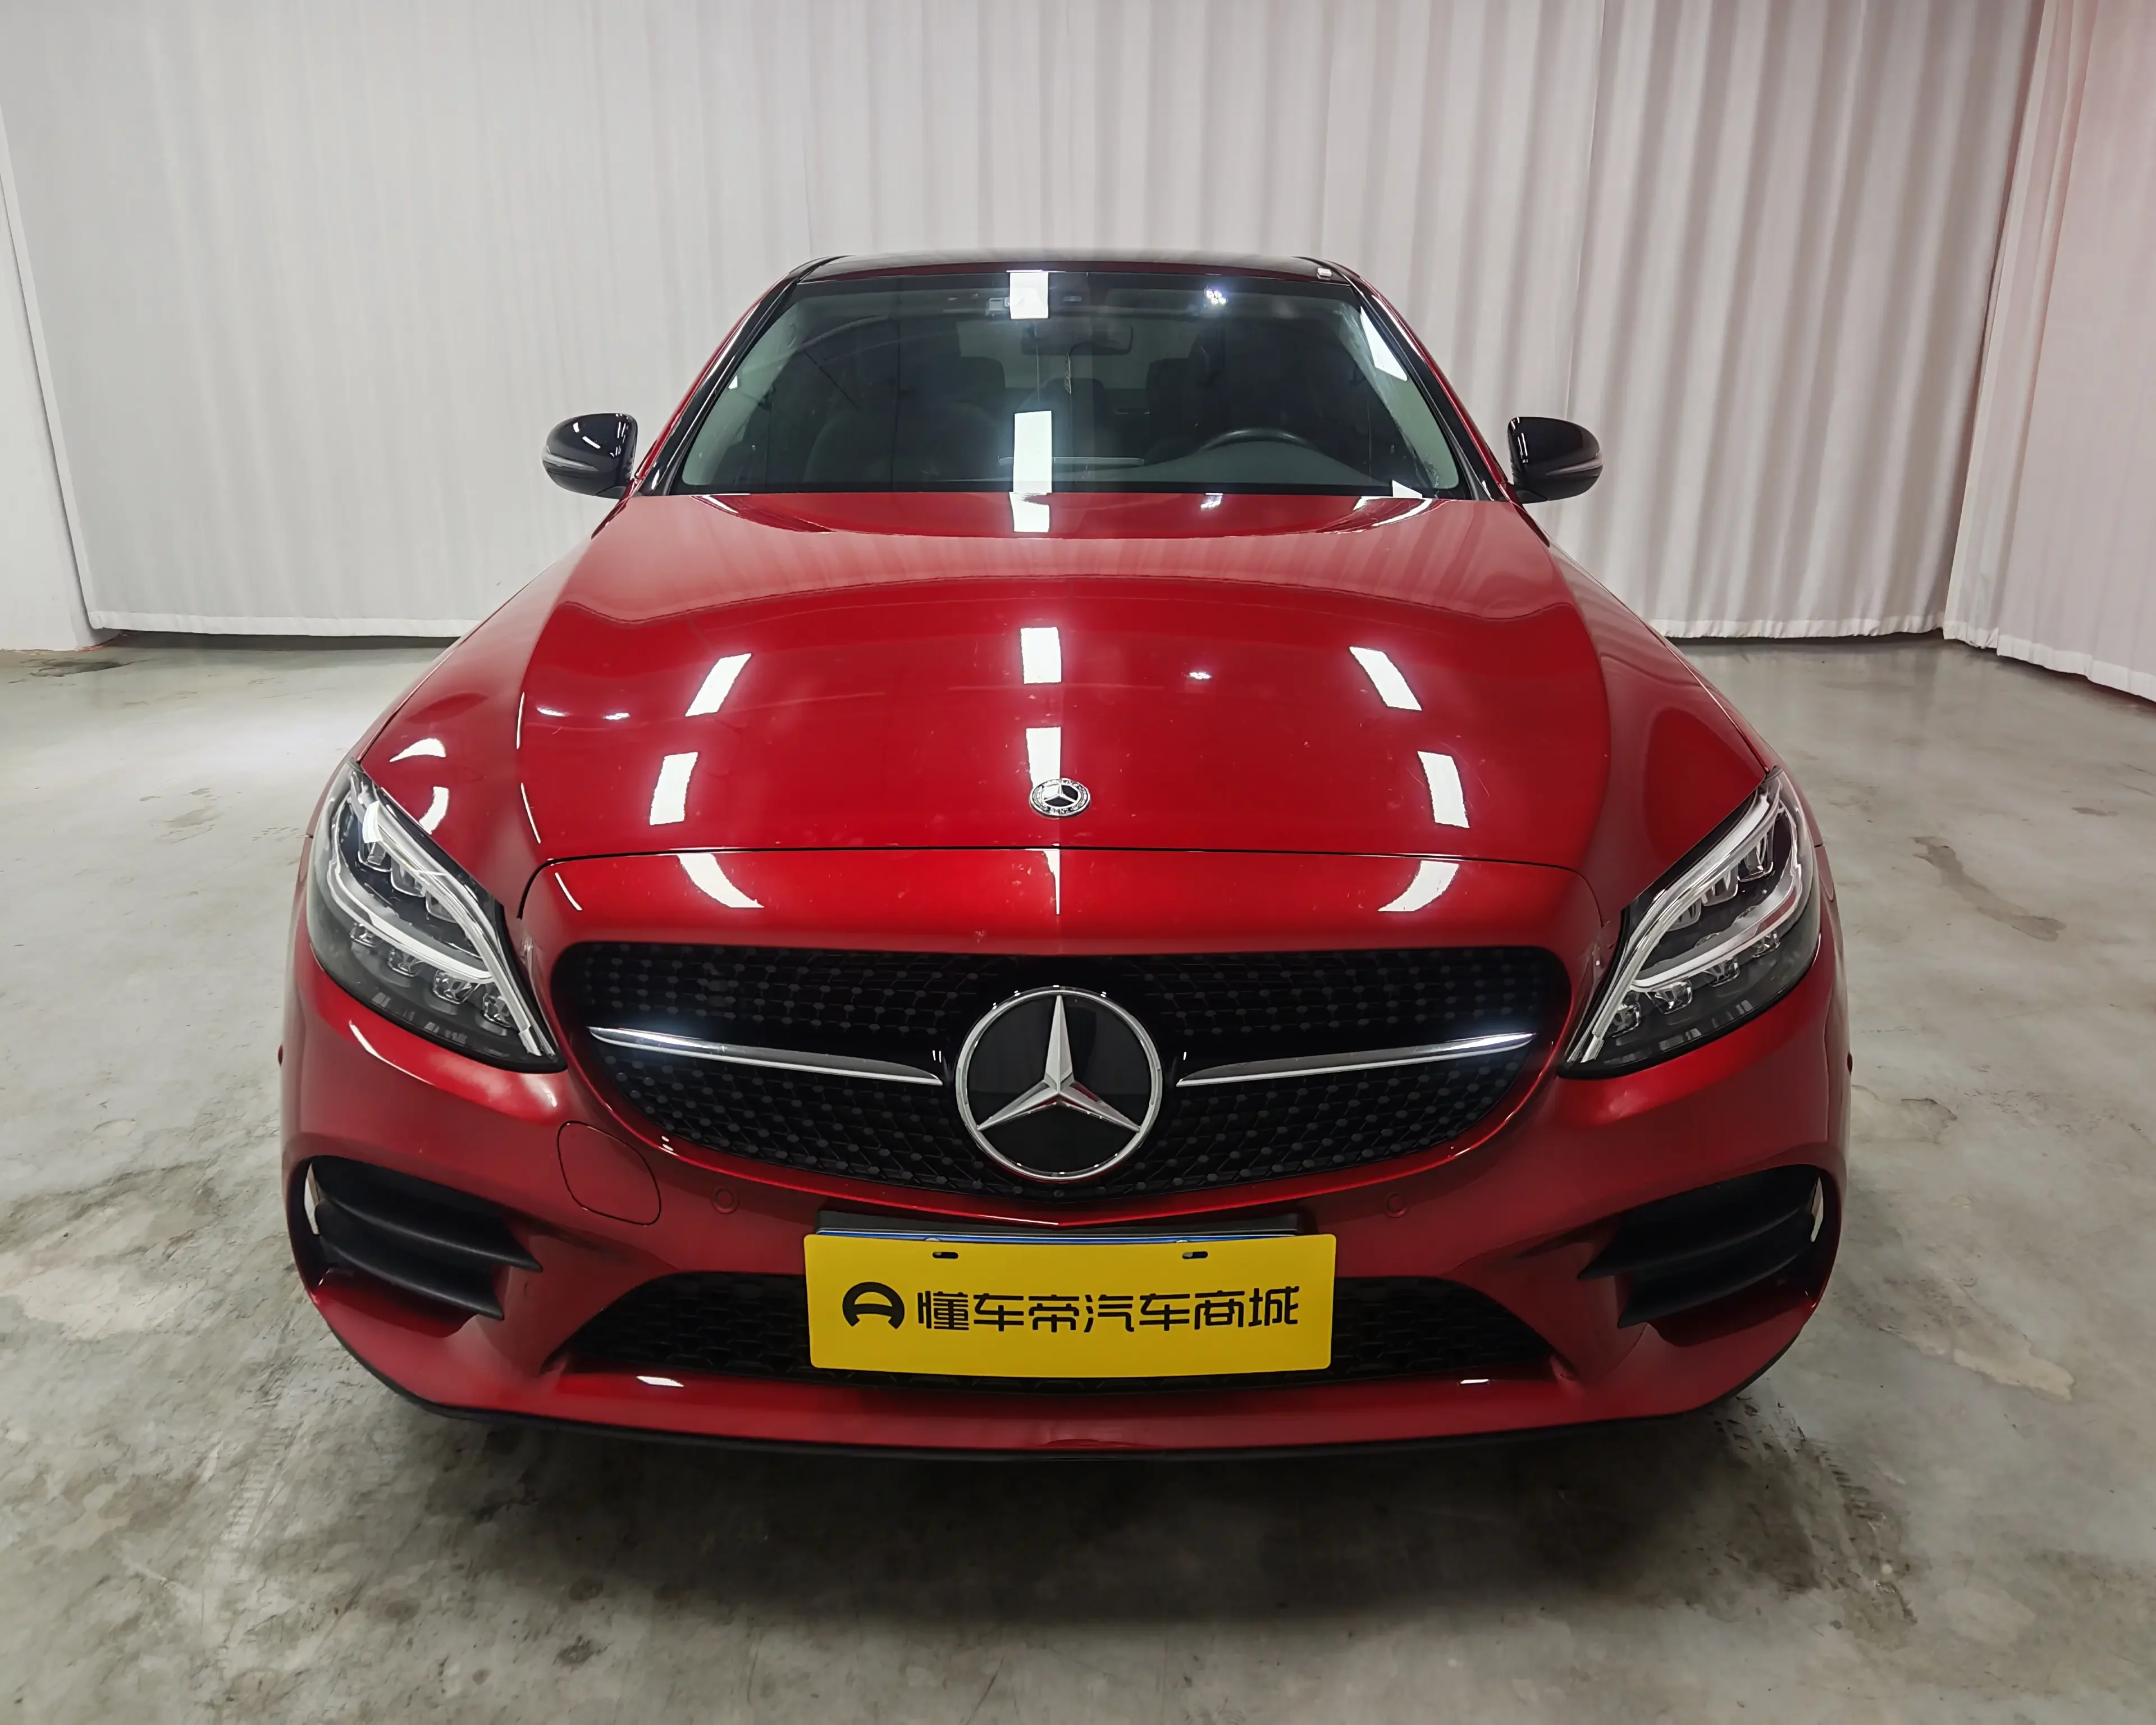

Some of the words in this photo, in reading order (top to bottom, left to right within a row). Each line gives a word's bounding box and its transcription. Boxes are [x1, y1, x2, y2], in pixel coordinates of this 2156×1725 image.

[917, 1285, 1300, 1333] 懂车帝汽车商城
